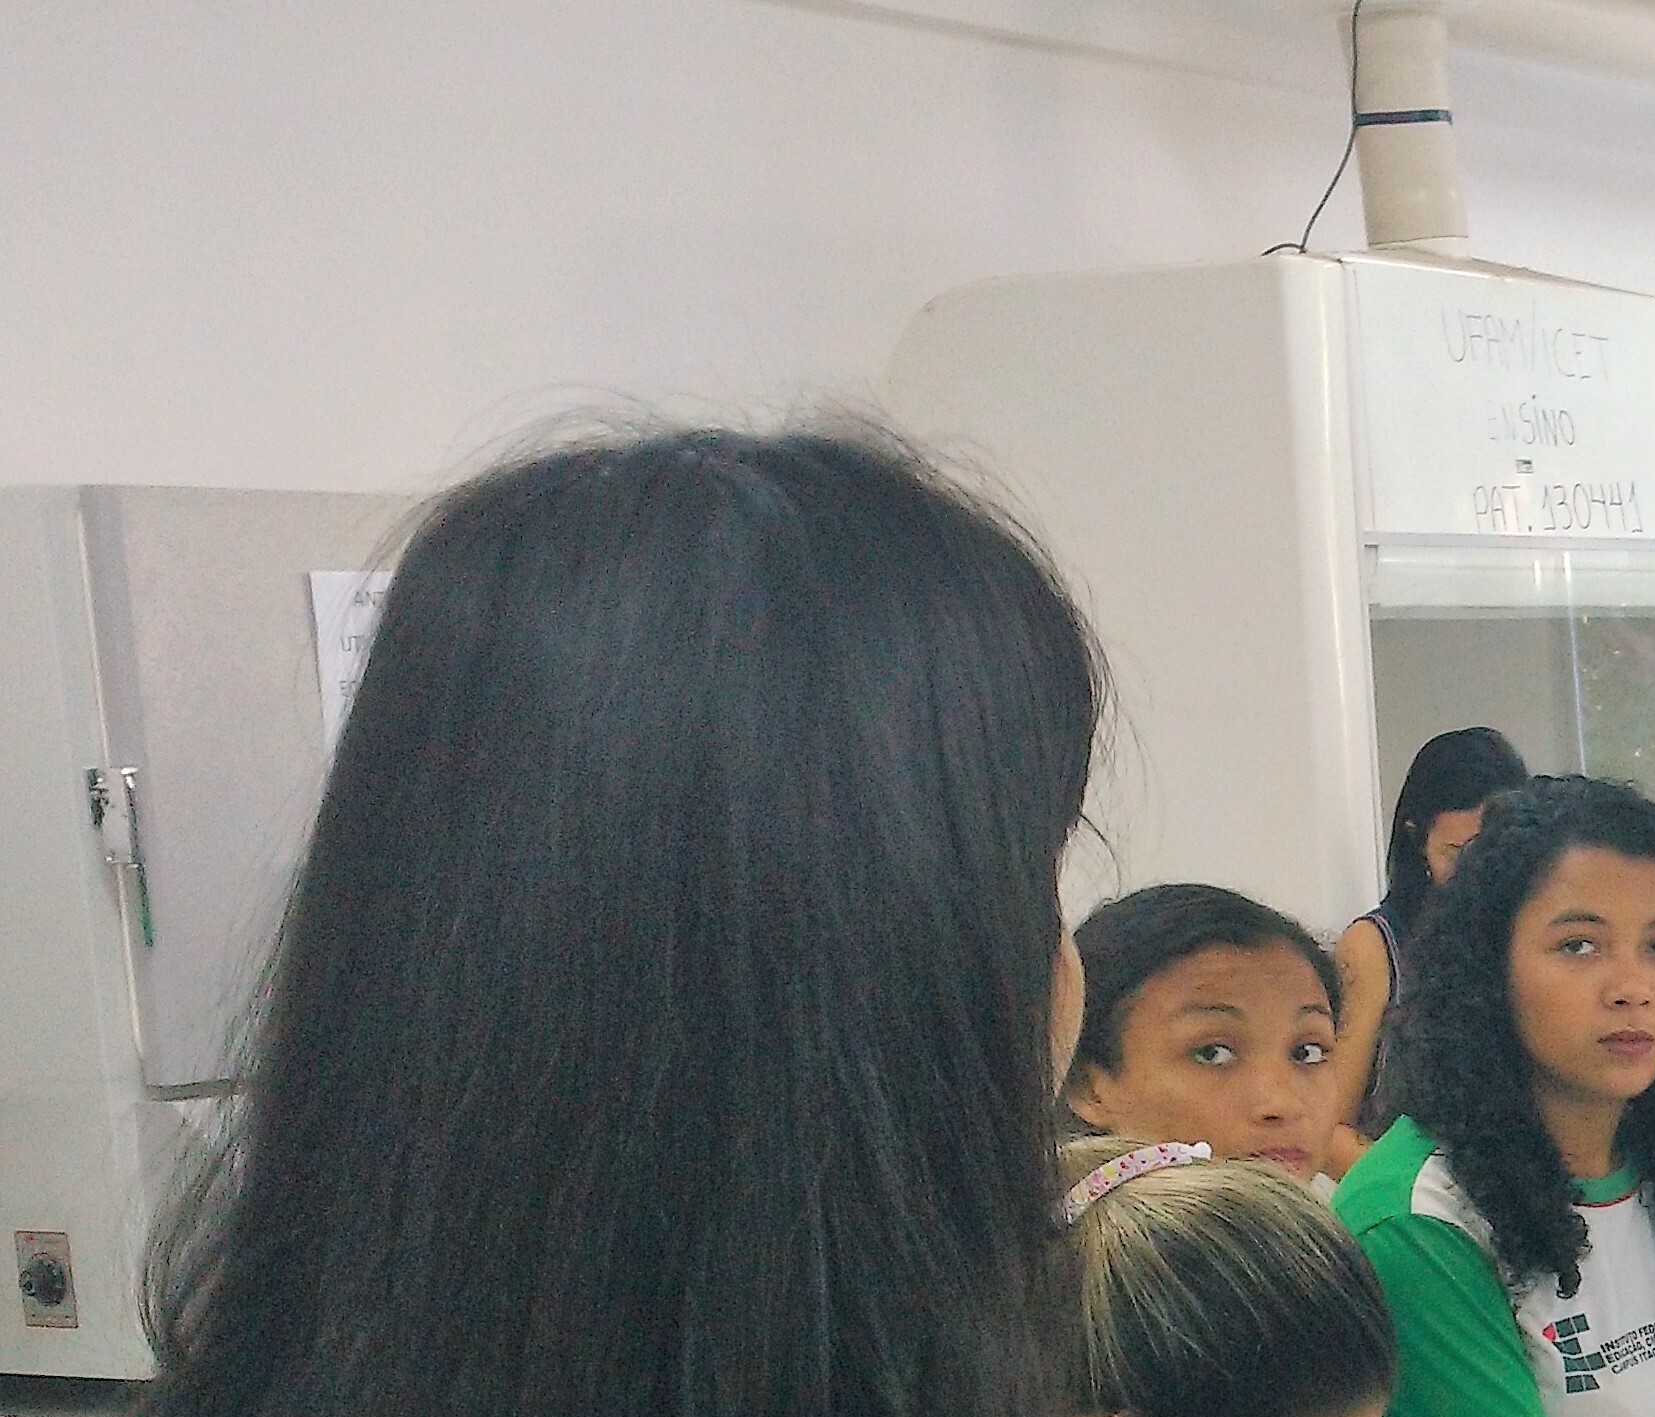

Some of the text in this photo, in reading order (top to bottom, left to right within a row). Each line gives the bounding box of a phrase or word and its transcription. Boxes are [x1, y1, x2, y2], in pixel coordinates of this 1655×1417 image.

[1441, 300, 1610, 382] UFAM/ICET
[1473, 480, 1645, 534] PAT. 130441
